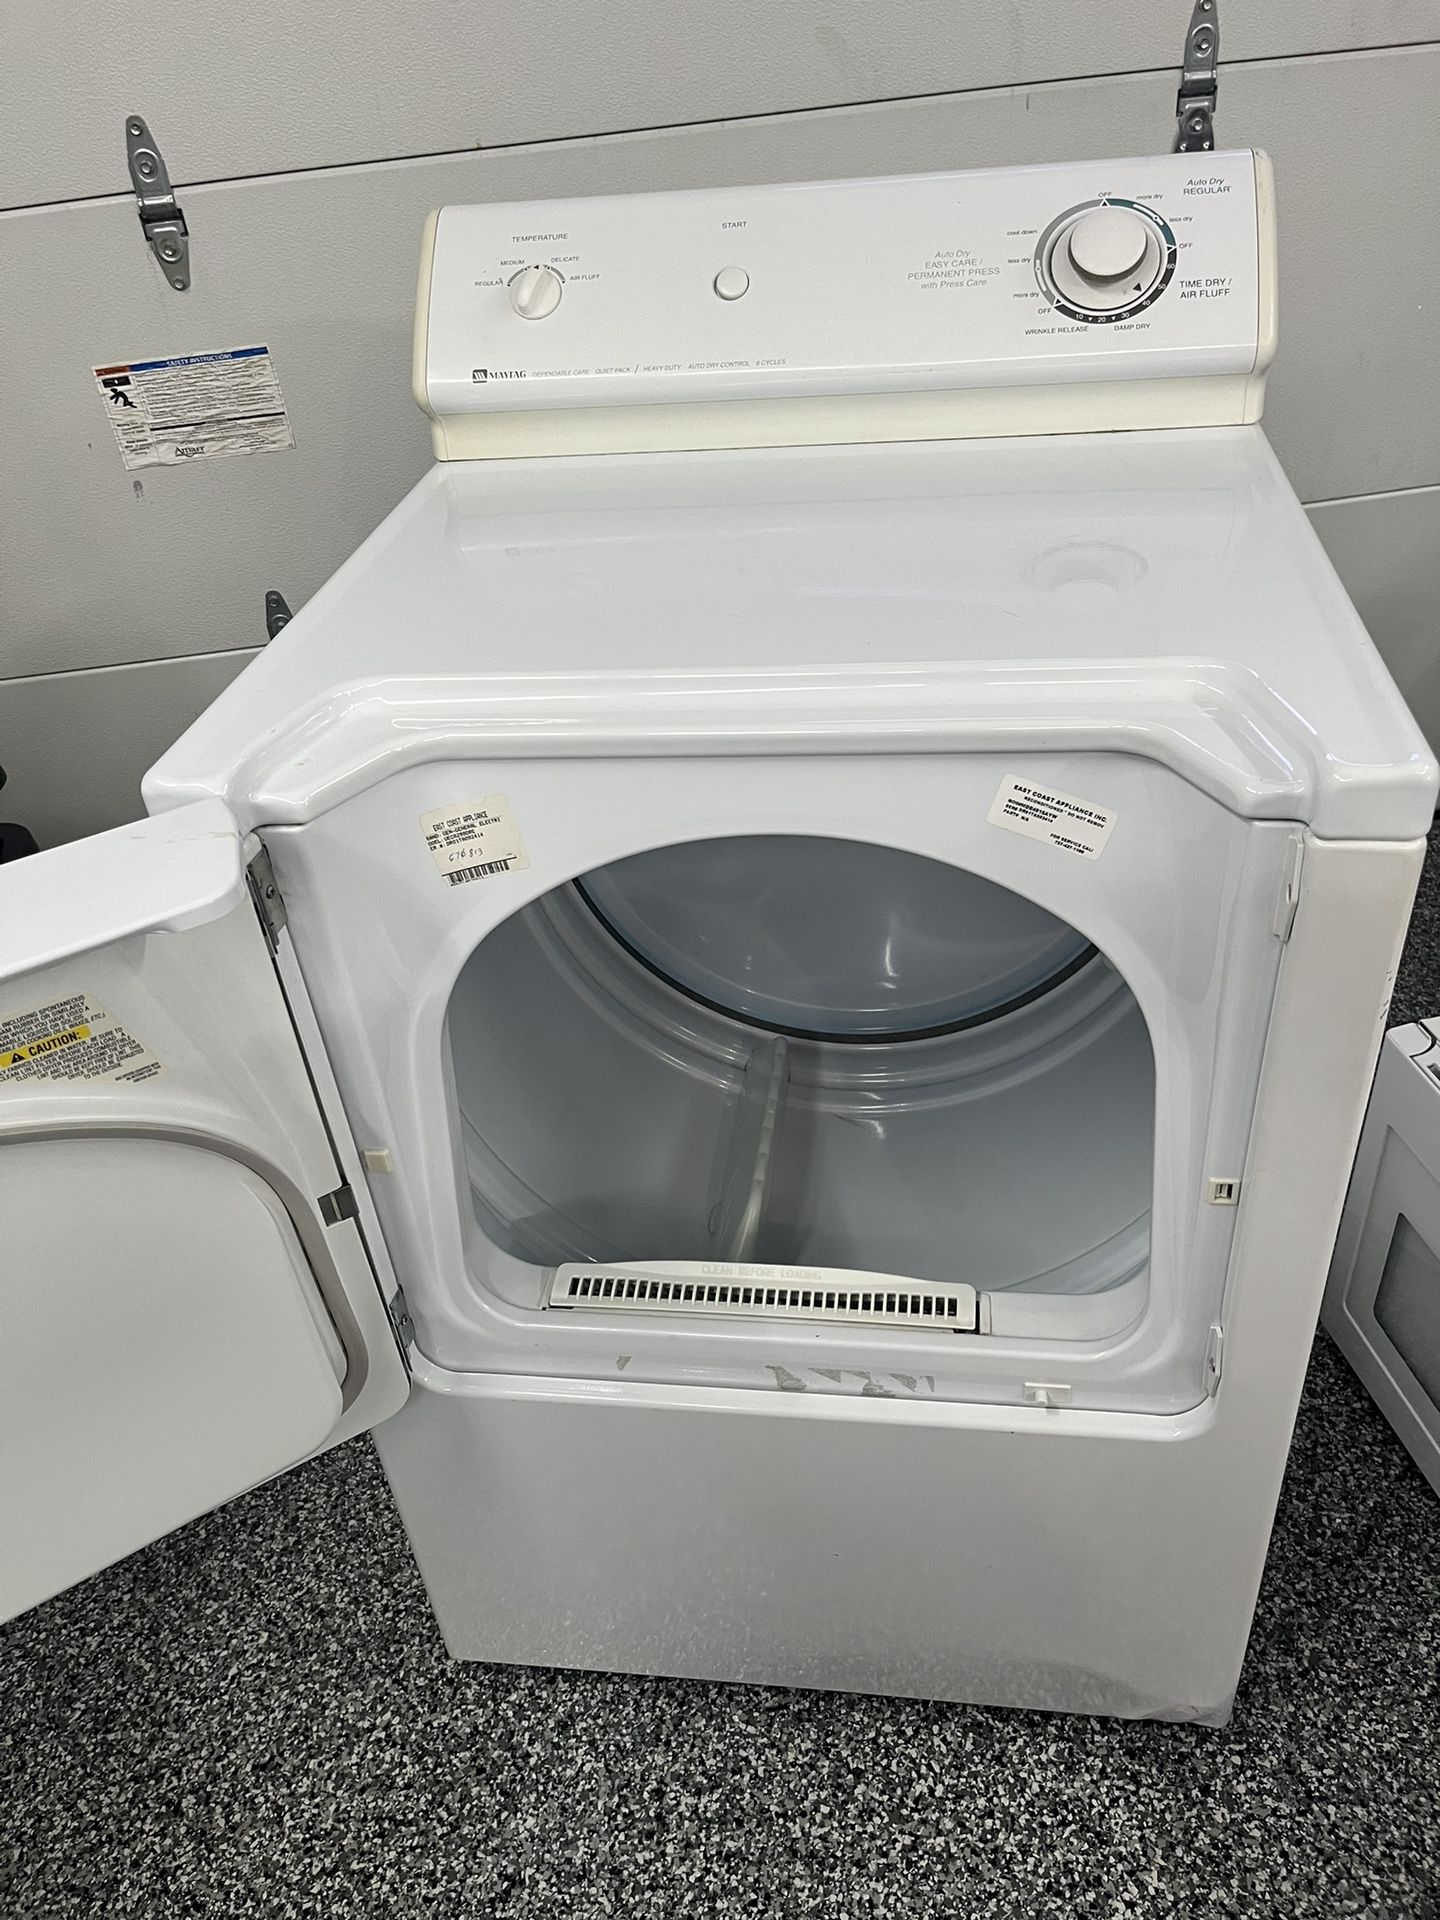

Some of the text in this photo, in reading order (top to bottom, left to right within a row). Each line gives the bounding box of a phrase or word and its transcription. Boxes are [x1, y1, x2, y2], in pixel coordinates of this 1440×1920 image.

[1183, 186, 1231, 195] REGULAR
[721, 221, 747, 230] START
[512, 233, 568, 243] TEMPERATURE
[934, 249, 971, 259] Auto Dry
[925, 260, 949, 269] EASY
[951, 258, 977, 268] CARE
[907, 267, 1001, 280] PERMANENT PRESS
[474, 279, 504, 287] REGULAR
[921, 279, 987, 290] with Press Care
[1180, 279, 1202, 288] TIME
[1205, 278, 1226, 287] DRY
[1180, 288, 1230, 299] AIR FLUFF
[1025, 325, 1089, 336] WRINKLE RELEASE
[720, 360, 750, 368] CONTROL
[489, 370, 527, 379] MAYTAG
[1014, 785, 1031, 794] EAST
[1032, 791, 1055, 803] COAST
[1056, 800, 1093, 817] APPLIANCE
[433, 823, 445, 831] EAST
[447, 818, 461, 827] COAST
[2, 995, 85, 1028] INCLUDING SPONTANEOUS
[13, 1017, 40, 1030] RUBBER
[51, 1001, 85, 1016] SIMILARLY
[11, 1026, 33, 1037] WHICH
[35, 1021, 48, 1029] YOU
[49, 1015, 64, 1024] HAVE
[66, 1008, 84, 1017] USED
[23, 1027, 50, 1040] LIQUIDS
[61, 1014, 84, 1026] SOLIDS
[27, 1032, 52, 1044] COOKING
[28, 1031, 81, 1057] CAUTION:
[7, 1061, 32, 1073] FABRICS
[33, 1051, 59, 1063] CLEANED
[99, 1031, 114, 1039] SURE
[87, 1051, 108, 1061] AROUND
[119, 1040, 136, 1049] DRYER
[0, 1071, 19, 1081] CLEAN
[21, 1066, 35, 1074] LINT
[36, 1058, 57, 1068] FILTER
[58, 1048, 82, 1060] BEFORE
[83, 1042, 99, 1051] EACH
[16, 1037, 131, 1081] CLOTHES DRYER PRODUCES COMBUSTIBLE
[52, 1069, 73, 1080] SHOULD
[81, 1061, 94, 1069] KEPT
[68, 1070, 84, 1079] DRYER
[87, 1062, 107, 1073] SHOULD
[701, 1263, 822, 1280] CLEAN BEFORE LOADING
